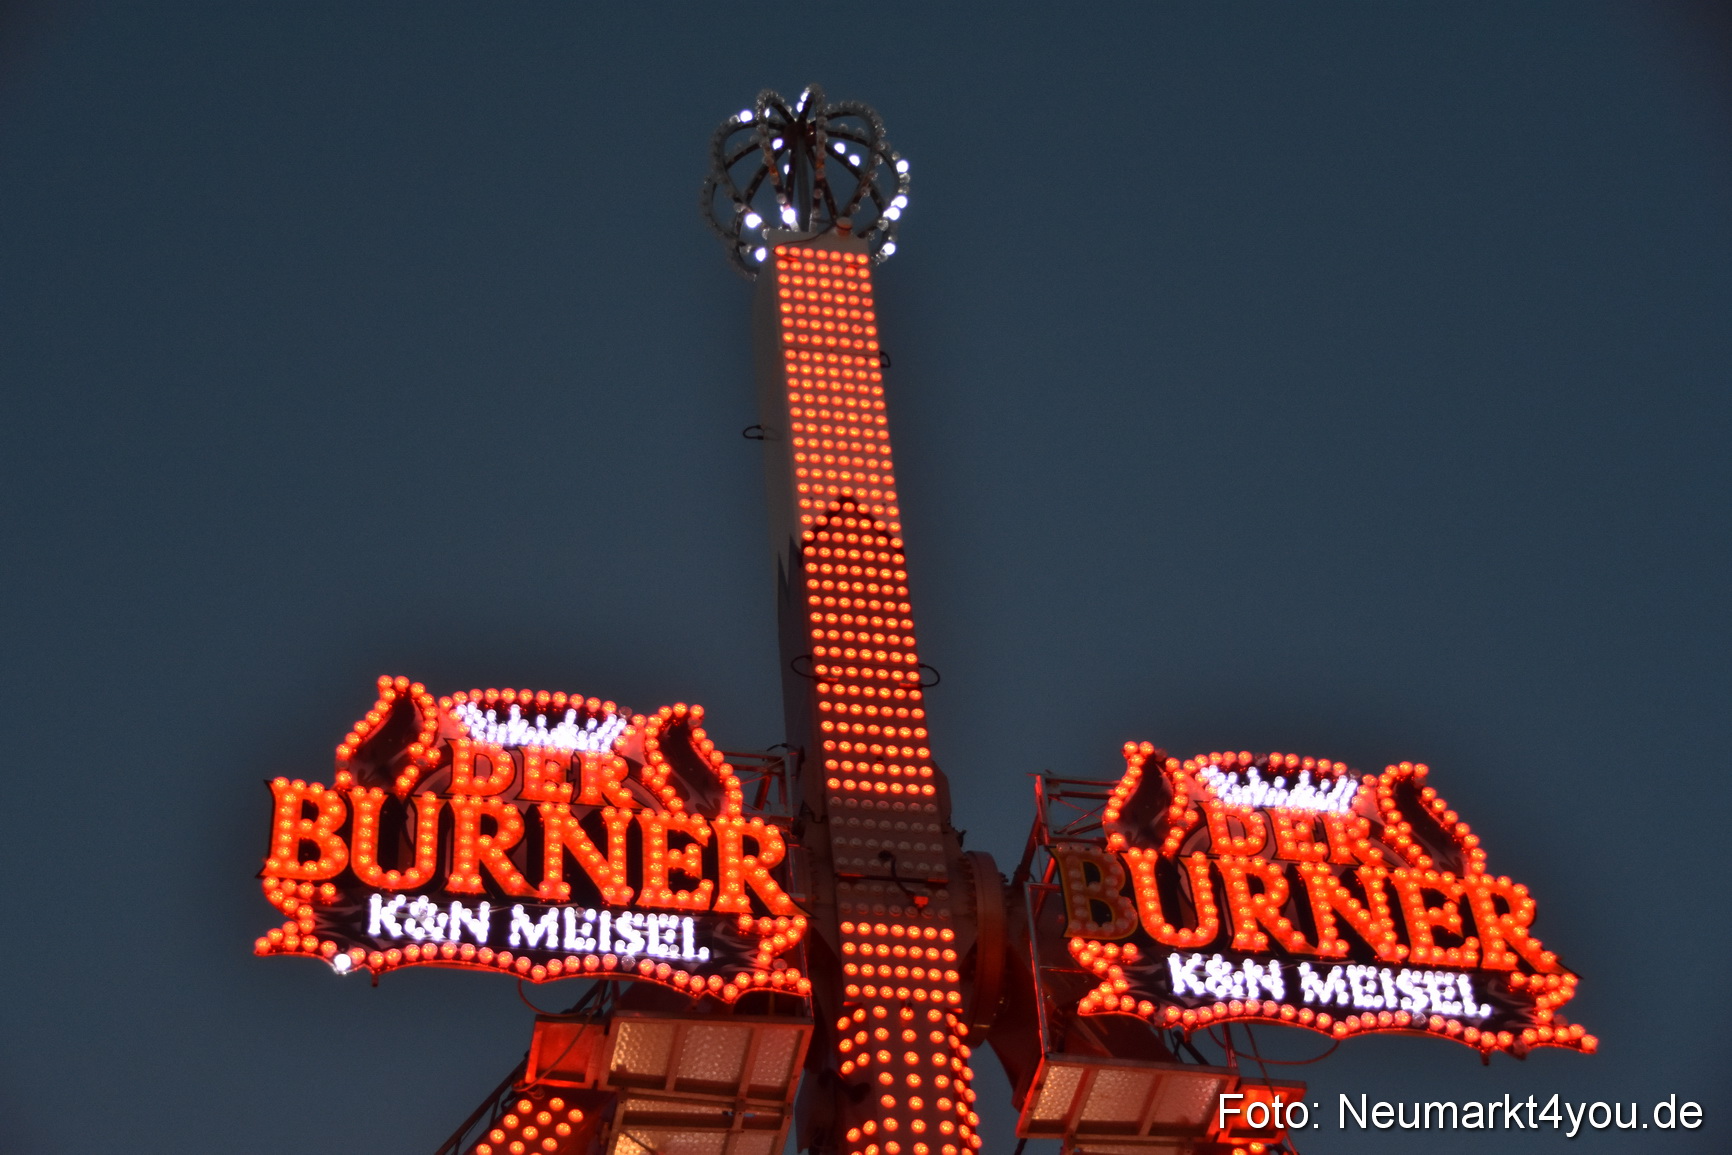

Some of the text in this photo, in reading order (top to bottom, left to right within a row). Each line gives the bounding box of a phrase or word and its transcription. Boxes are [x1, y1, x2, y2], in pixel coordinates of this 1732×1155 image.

[448, 738, 637, 805] DER
[260, 778, 804, 914] BURNER
[1206, 800, 1384, 865] DER
[367, 893, 710, 961] K&N MEISEL
[1057, 843, 1566, 972] BURNER
[1168, 953, 1492, 1018] K&N MEISEL
